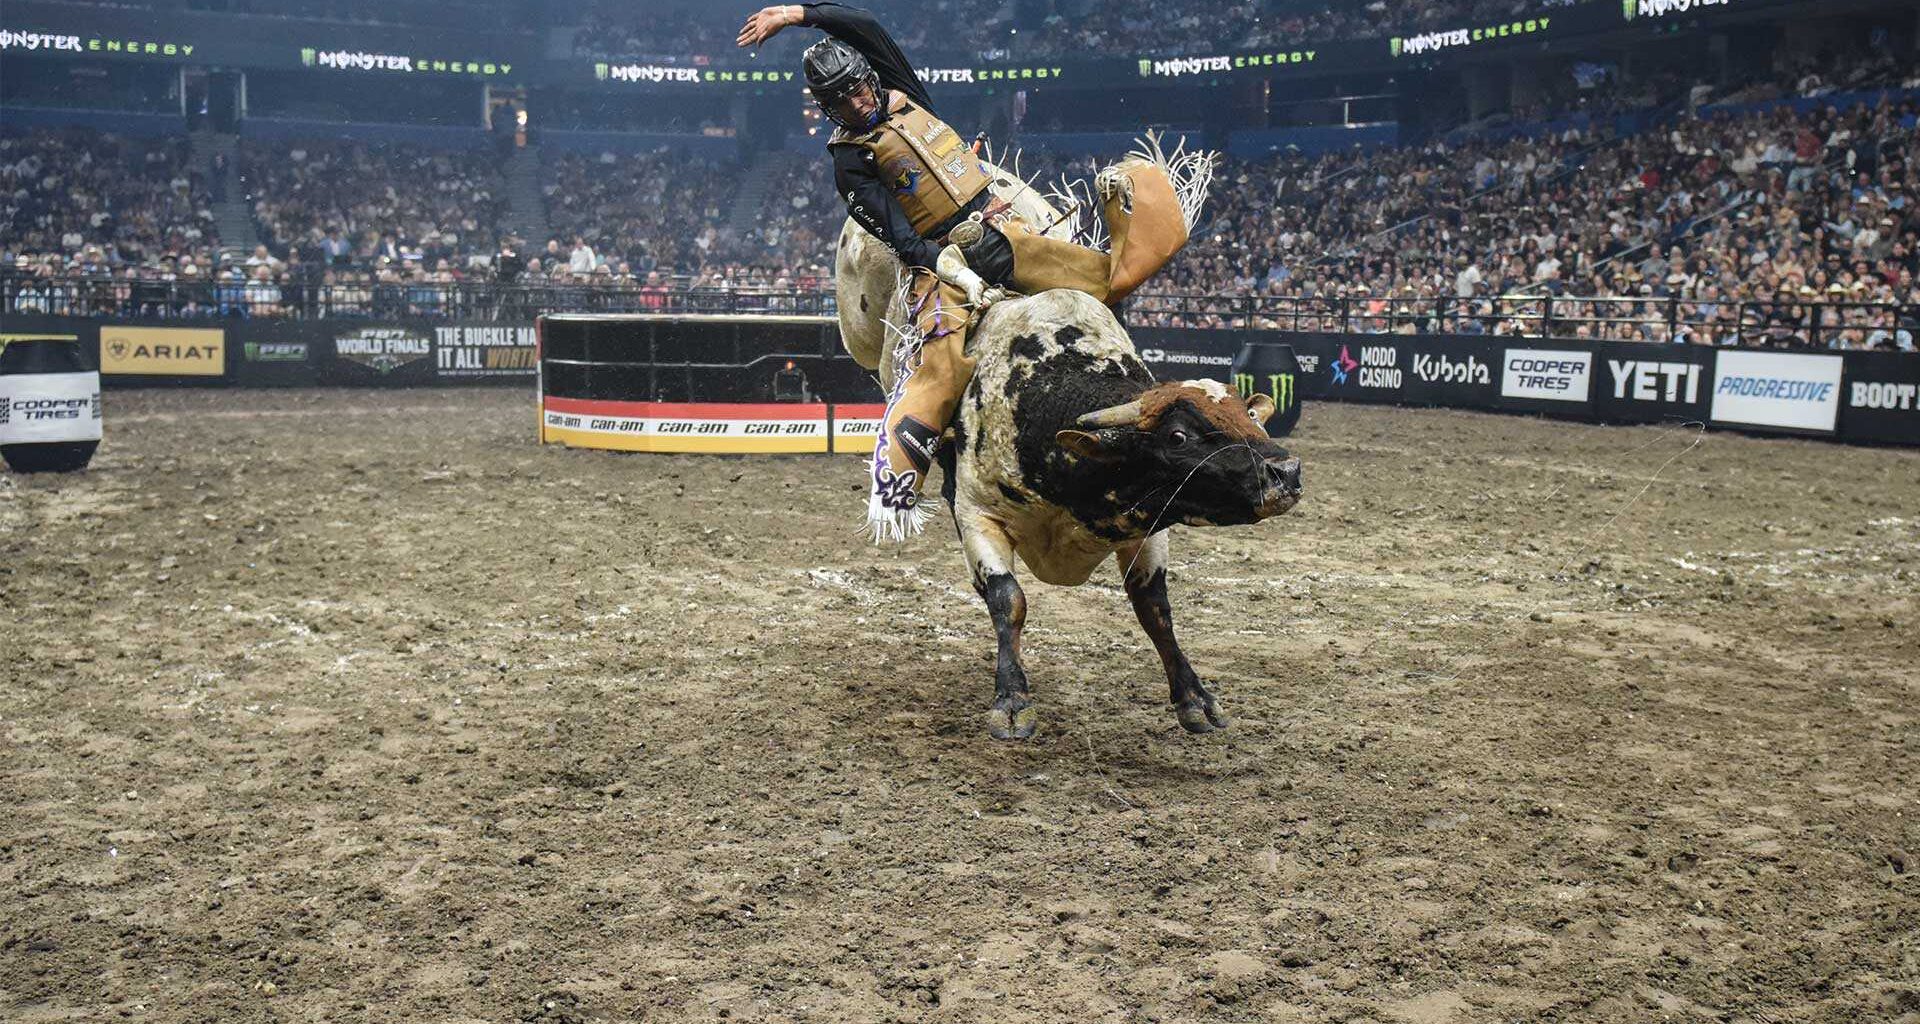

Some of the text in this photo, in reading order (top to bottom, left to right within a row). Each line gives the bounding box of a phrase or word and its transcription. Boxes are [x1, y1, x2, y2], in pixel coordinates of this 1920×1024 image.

[0, 29, 193, 55] ONSTER ENERGY
[1403, 17, 1550, 54] MONSTER ENERGY
[319, 49, 512, 75] MONSTER ENERGY
[1154, 51, 1316, 76] MONSTER ENERGY
[611, 64, 794, 83] MONSTER ENERGY
[914, 67, 1062, 83] NSTER ENERGY
[336, 339, 430, 354] WORLD FINALS
[436, 327, 537, 346] THE BUCKLE MA
[134, 345, 218, 360] ARIAT
[438, 347, 453, 368] IT
[456, 347, 482, 368] ALL
[1167, 355, 1198, 364] MOTOR
[1199, 356, 1233, 366] RACING
[1297, 355, 1319, 365] RCE
[1361, 347, 1396, 367] MODO
[1413, 354, 1489, 384] Kubota
[1509, 359, 1585, 375] COOPER
[1359, 367, 1402, 389] CASINO
[1518, 375, 1571, 391] TIRES
[1609, 360, 1703, 403] YETI
[1717, 376, 1834, 402] PROGRESSIVE
[1850, 381, 1916, 410] BOOT
[13, 398, 88, 411] COOPER
[24, 409, 80, 420] TIRES
[548, 413, 582, 428] can-am
[590, 418, 645, 432] can-am
[657, 422, 729, 433] can-am
[743, 422, 817, 434] can-am
